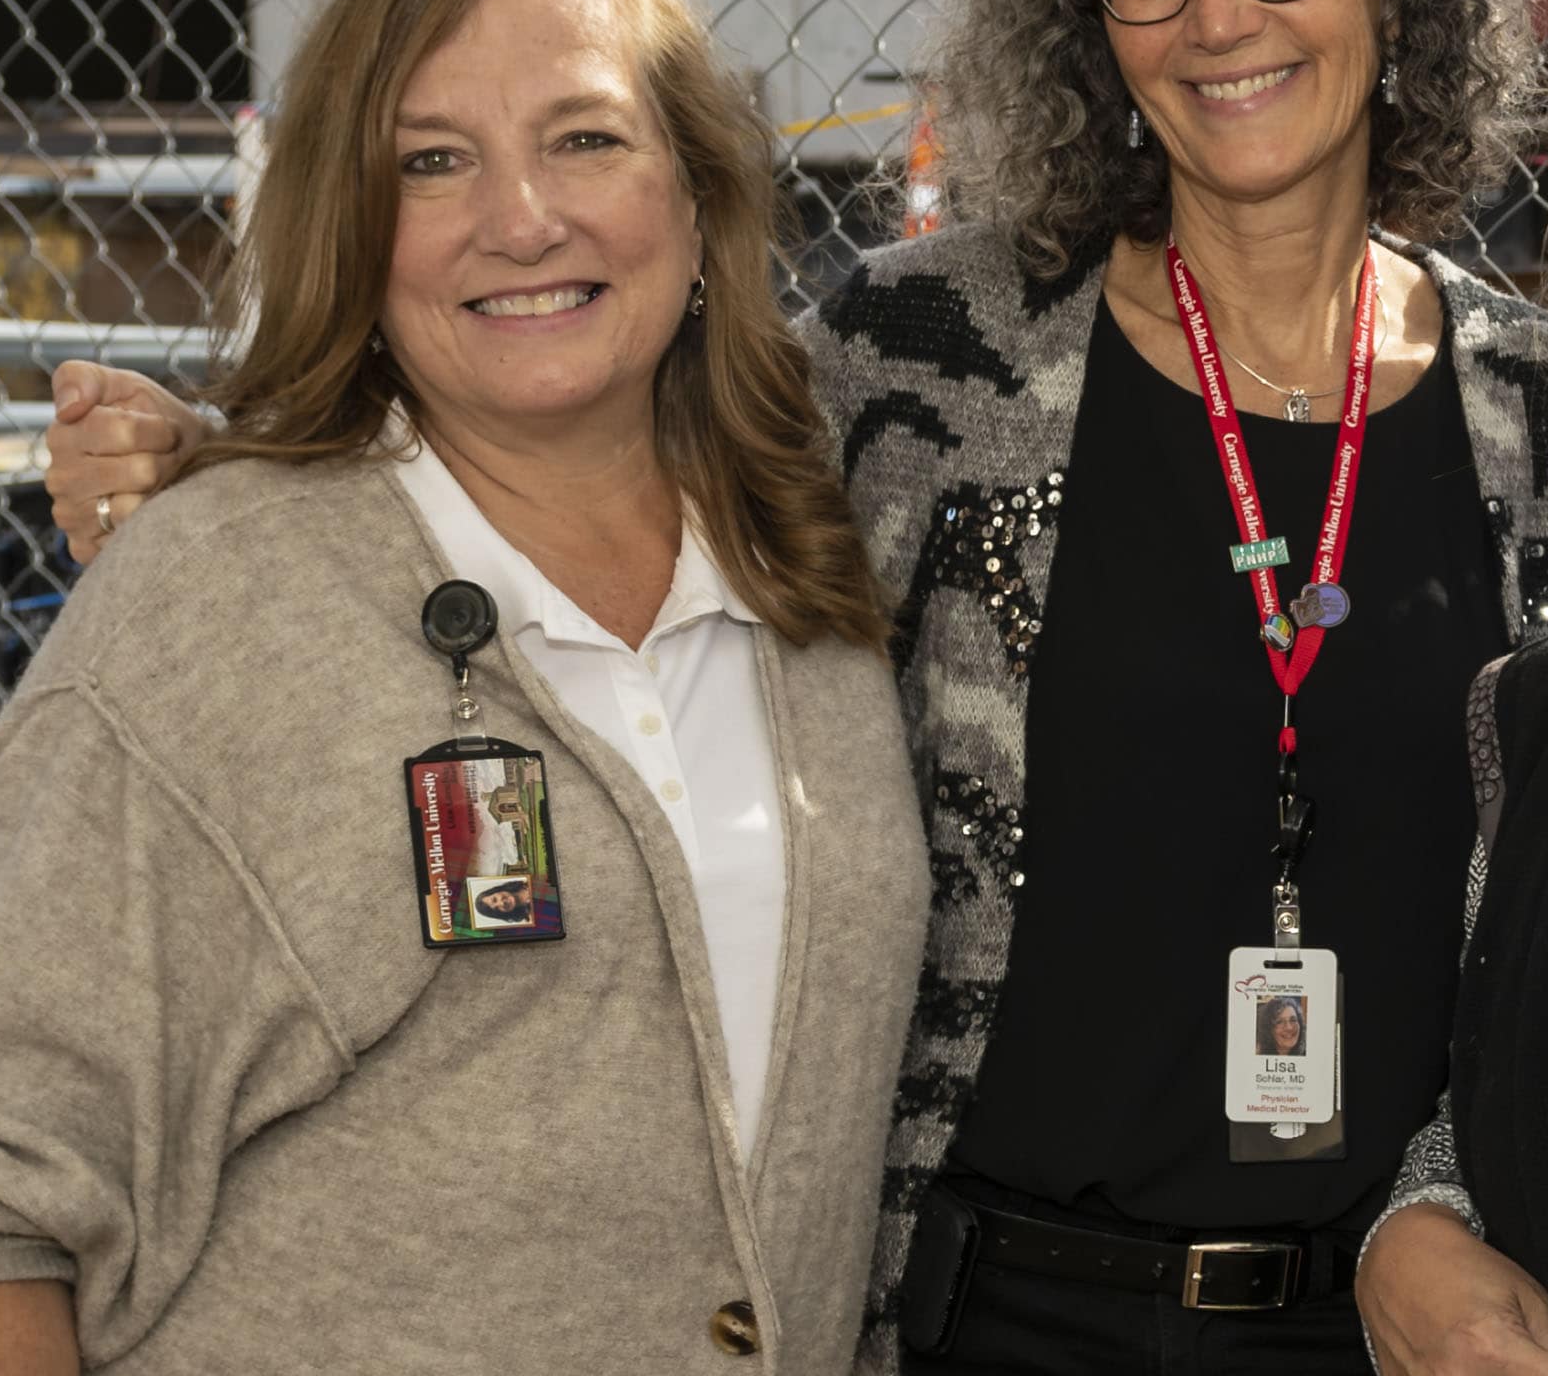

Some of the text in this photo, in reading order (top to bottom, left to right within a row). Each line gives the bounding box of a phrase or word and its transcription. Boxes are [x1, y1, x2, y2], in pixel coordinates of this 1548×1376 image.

[1173, 258, 1228, 419] Carnegie Mellon University
[1345, 371, 1367, 428] Carnegie
[1222, 432, 1250, 495] Carnegie
[1319, 508, 1342, 554] Mellon
[1331, 442, 1357, 508] University
[1236, 549, 1277, 568] PNHP
[421, 771, 453, 934] Carnegie Mellon University
[1265, 1058, 1297, 1073] Lisa
[1289, 1074, 1305, 1084] MD
[1247, 1104, 1310, 1114] Medical Director
[1261, 1094, 1299, 1105] Physician
